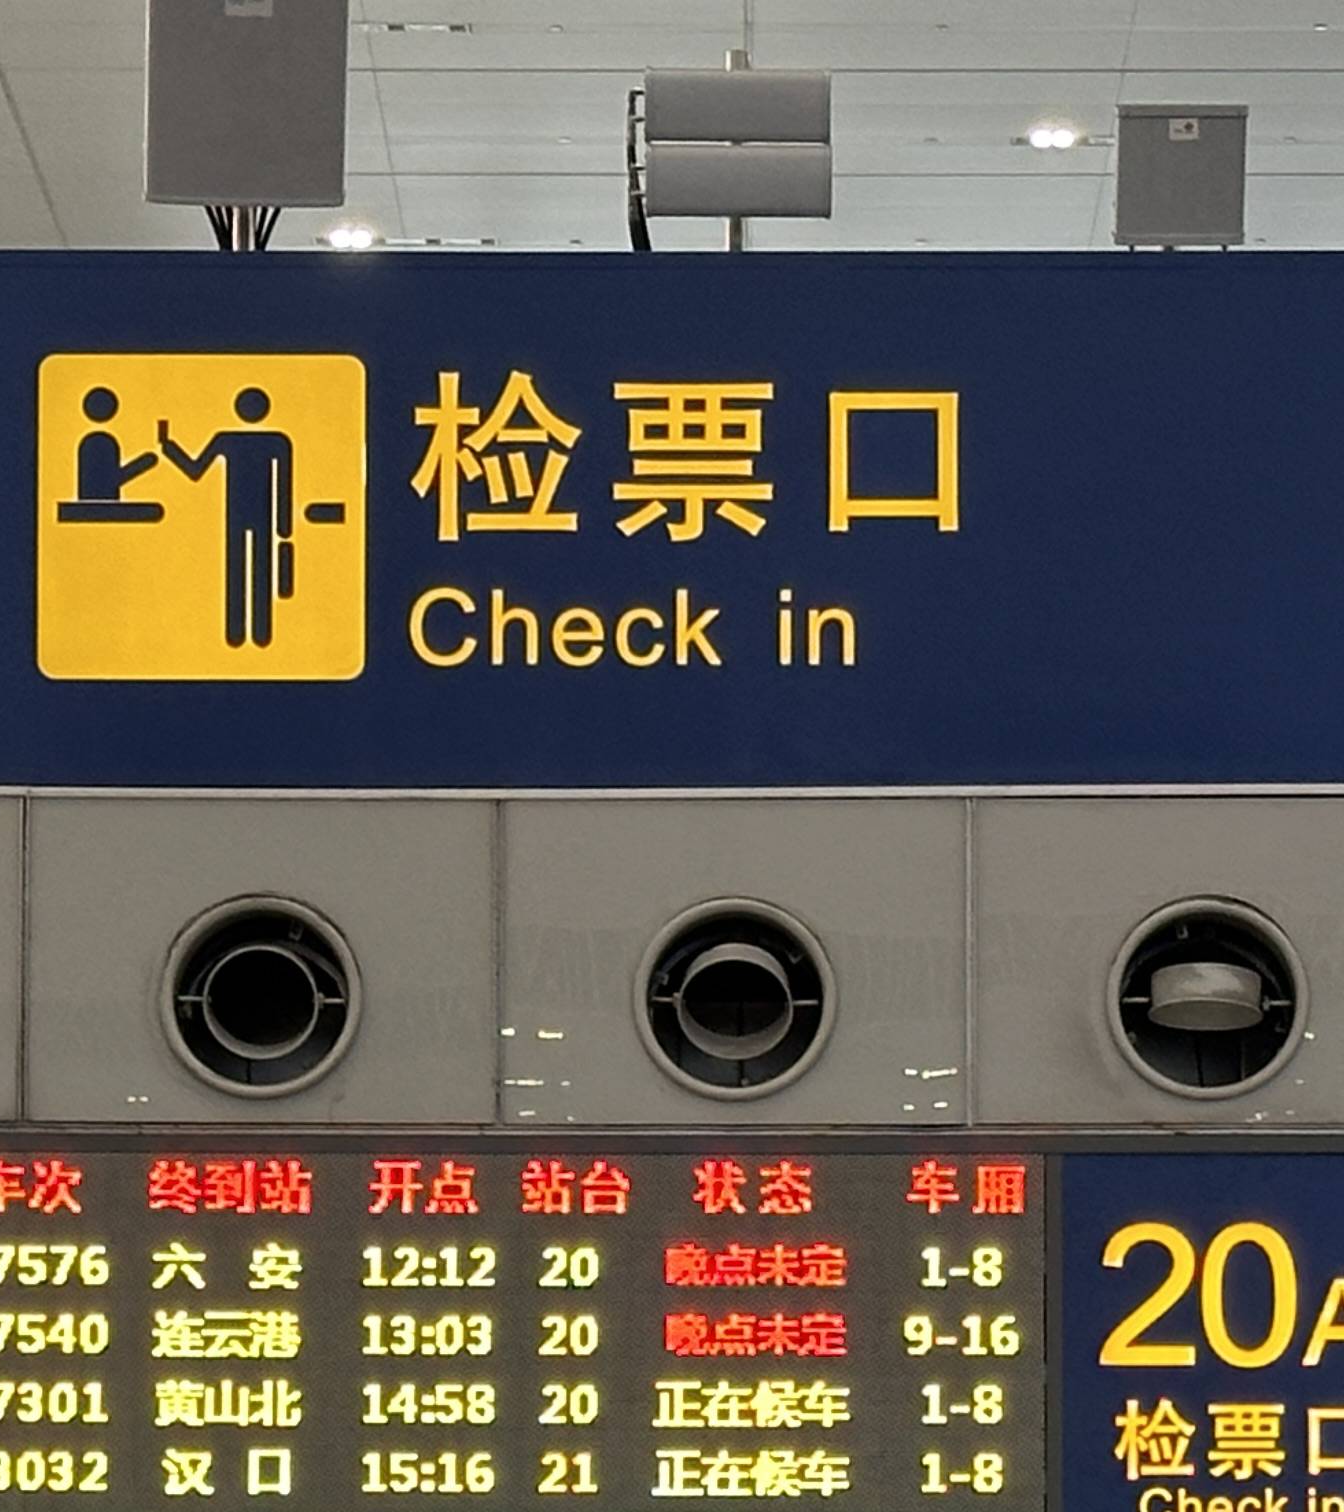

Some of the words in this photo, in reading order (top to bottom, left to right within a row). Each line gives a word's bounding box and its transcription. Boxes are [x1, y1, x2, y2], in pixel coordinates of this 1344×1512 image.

[411, 371, 960, 543] 检票口
[410, 588, 721, 668] Check
[778, 590, 859, 667] in
[149, 1157, 314, 1215] 终到站
[368, 1160, 481, 1215] 开点
[522, 1159, 632, 1215] 站台
[693, 1159, 814, 1216] 状态
[152, 1242, 304, 1291] 六安
[363, 1246, 497, 1288] 12:12
[539, 1247, 601, 1288] 20
[665, 1240, 849, 1288] 晚点未定
[922, 1246, 1004, 1288] 1-8
[152, 1310, 303, 1359] 连云港
[363, 1314, 494, 1357] 13:03
[539, 1315, 600, 1357] 20
[665, 1309, 849, 1358] 晚点未定
[904, 1314, 1021, 1357] 9-16
[155, 1378, 303, 1428] 黄山北
[363, 1383, 497, 1425] 14:58
[539, 1383, 600, 1425] 20
[652, 1380, 852, 1429] 正在候车
[922, 1383, 1005, 1426] 1-8
[161, 1448, 293, 1497] 汉口
[362, 1452, 497, 1494] 15:16
[538, 1452, 600, 1495] 21
[651, 1449, 852, 1498] 正在候车
[921, 1452, 1005, 1495] 1-8
